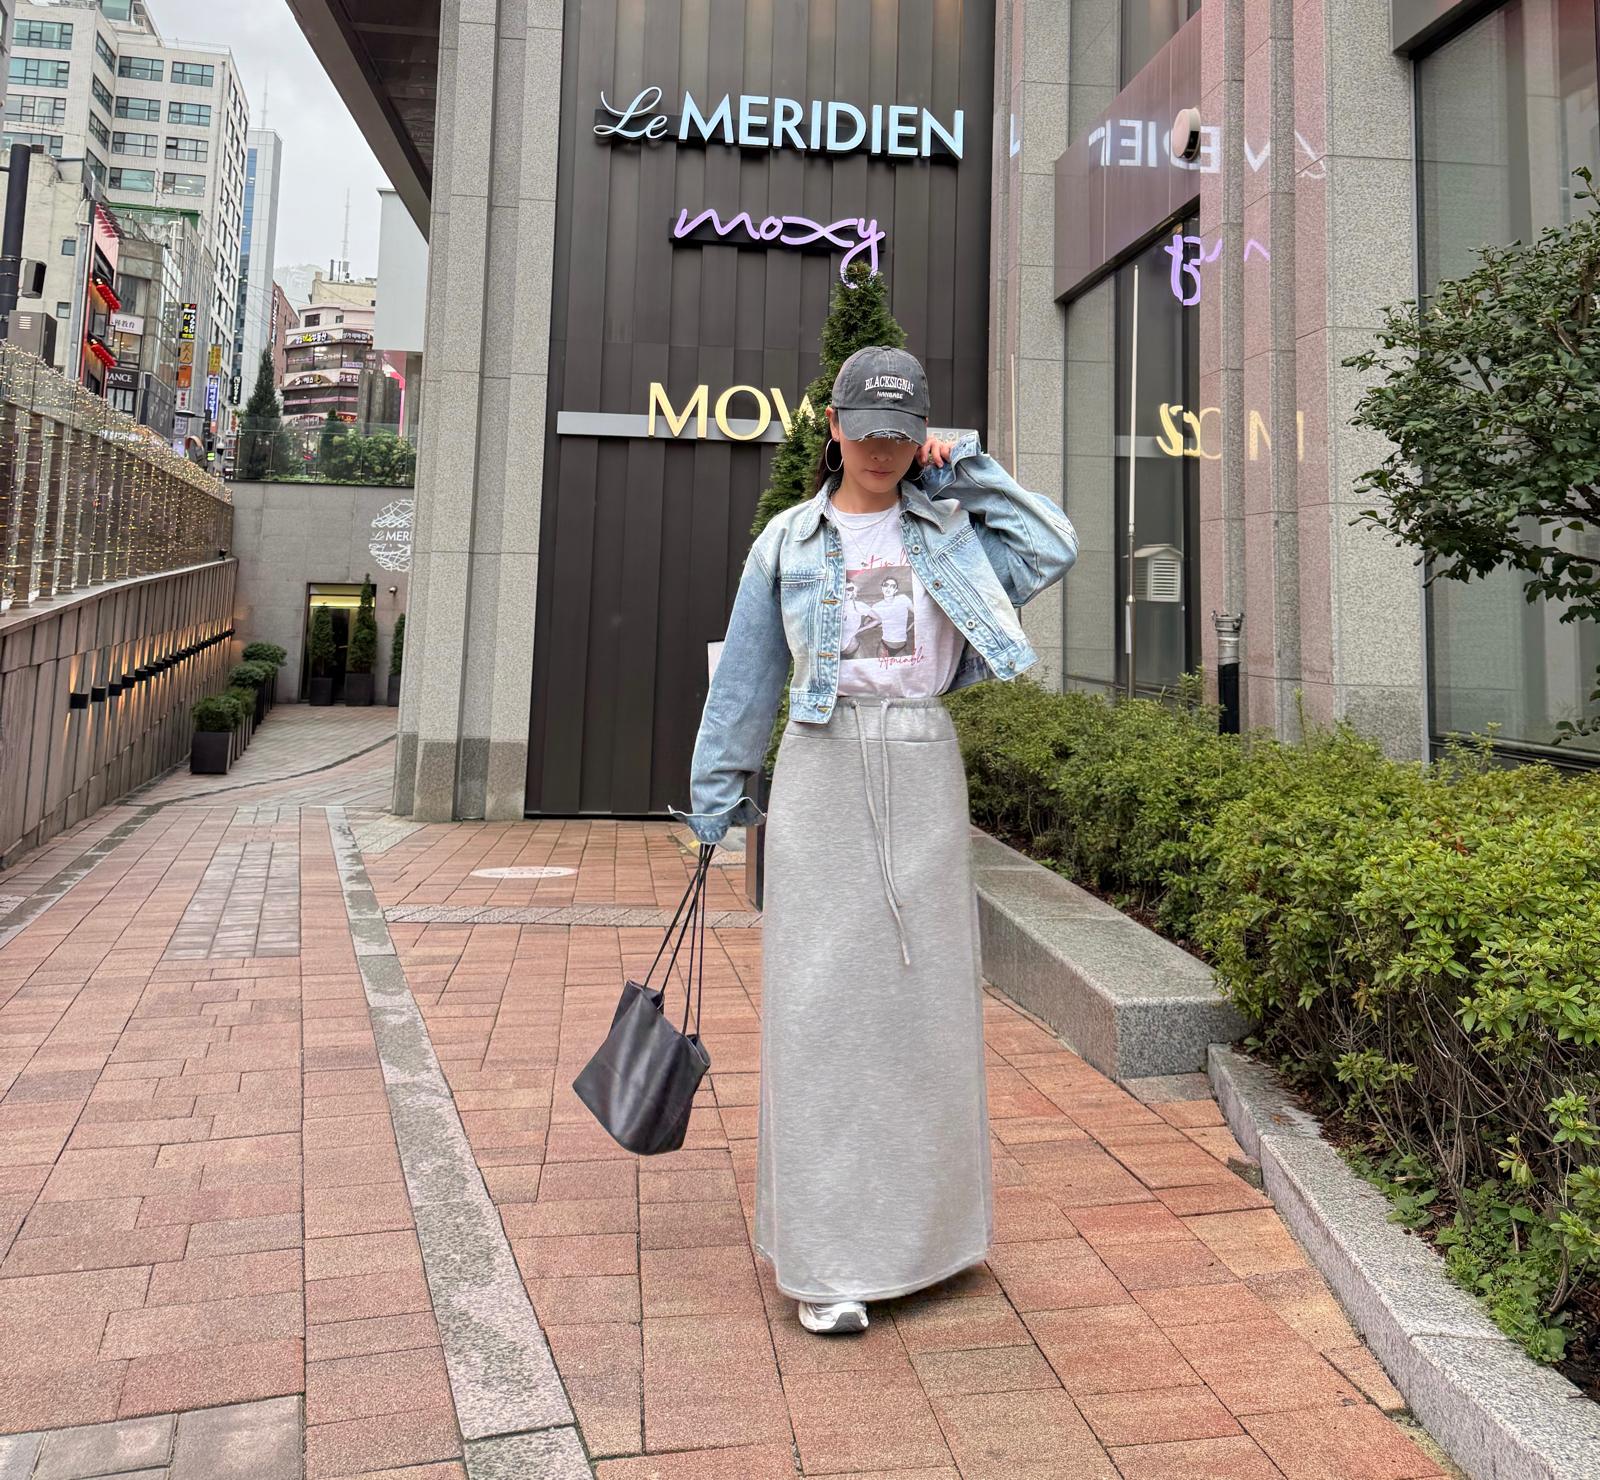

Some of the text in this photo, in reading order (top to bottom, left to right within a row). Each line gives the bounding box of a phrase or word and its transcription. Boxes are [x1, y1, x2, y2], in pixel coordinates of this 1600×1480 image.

[593, 86, 669, 140] Le
[678, 90, 964, 160] MERIDIEN
[673, 208, 885, 289] moxy
[864, 375, 914, 397] BLACKSIGNAL
